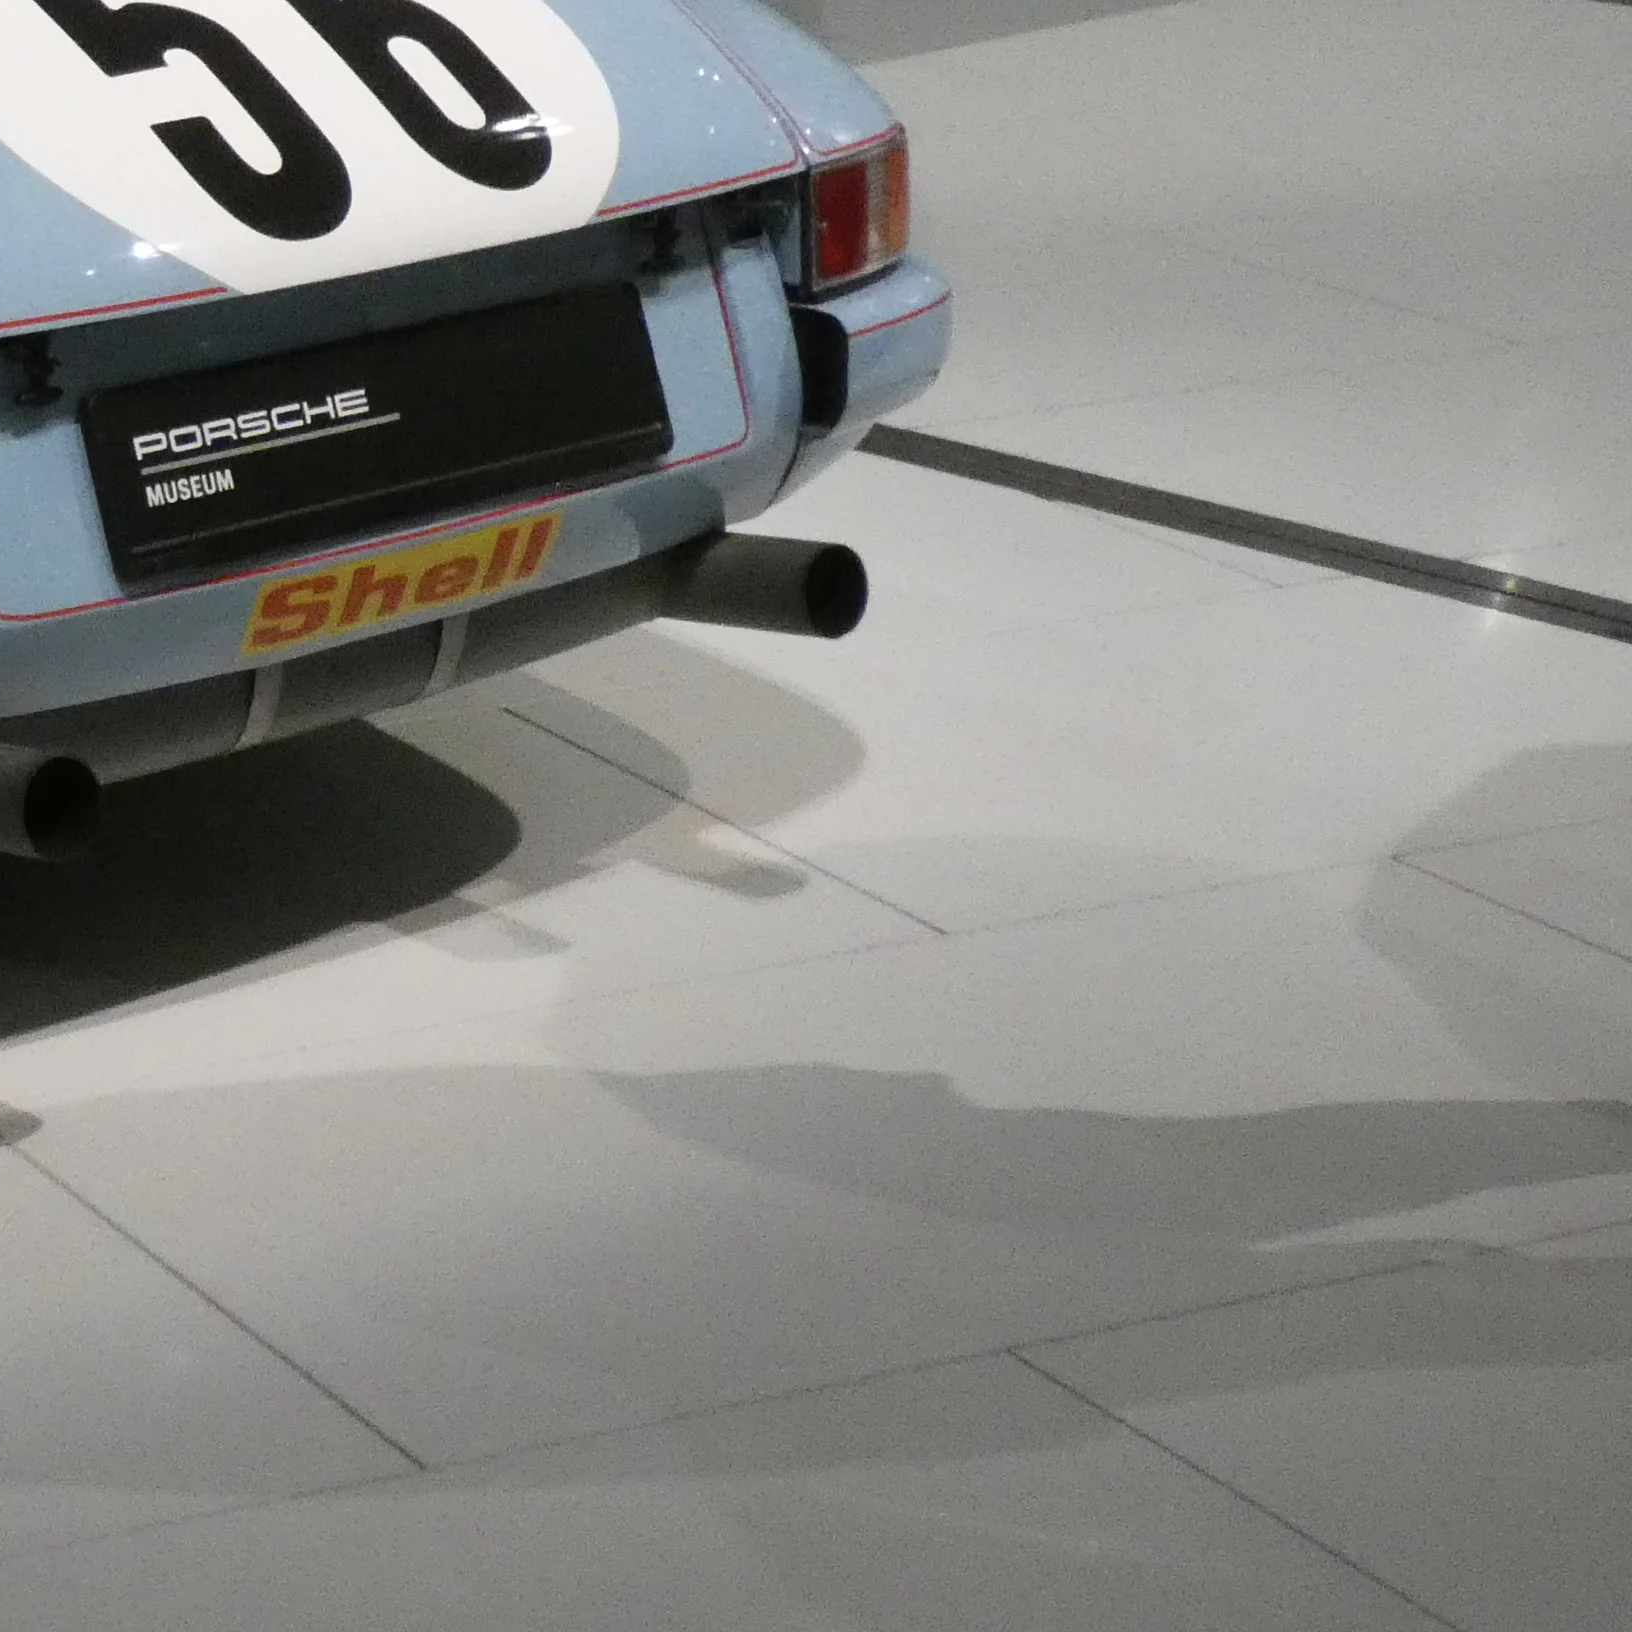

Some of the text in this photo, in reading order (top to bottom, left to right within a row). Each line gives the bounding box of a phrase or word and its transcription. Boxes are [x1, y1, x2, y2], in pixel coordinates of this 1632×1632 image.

[133, 388, 370, 461] PORSCHE
[145, 469, 235, 508] MUSEUM
[249, 519, 554, 652] Shell
